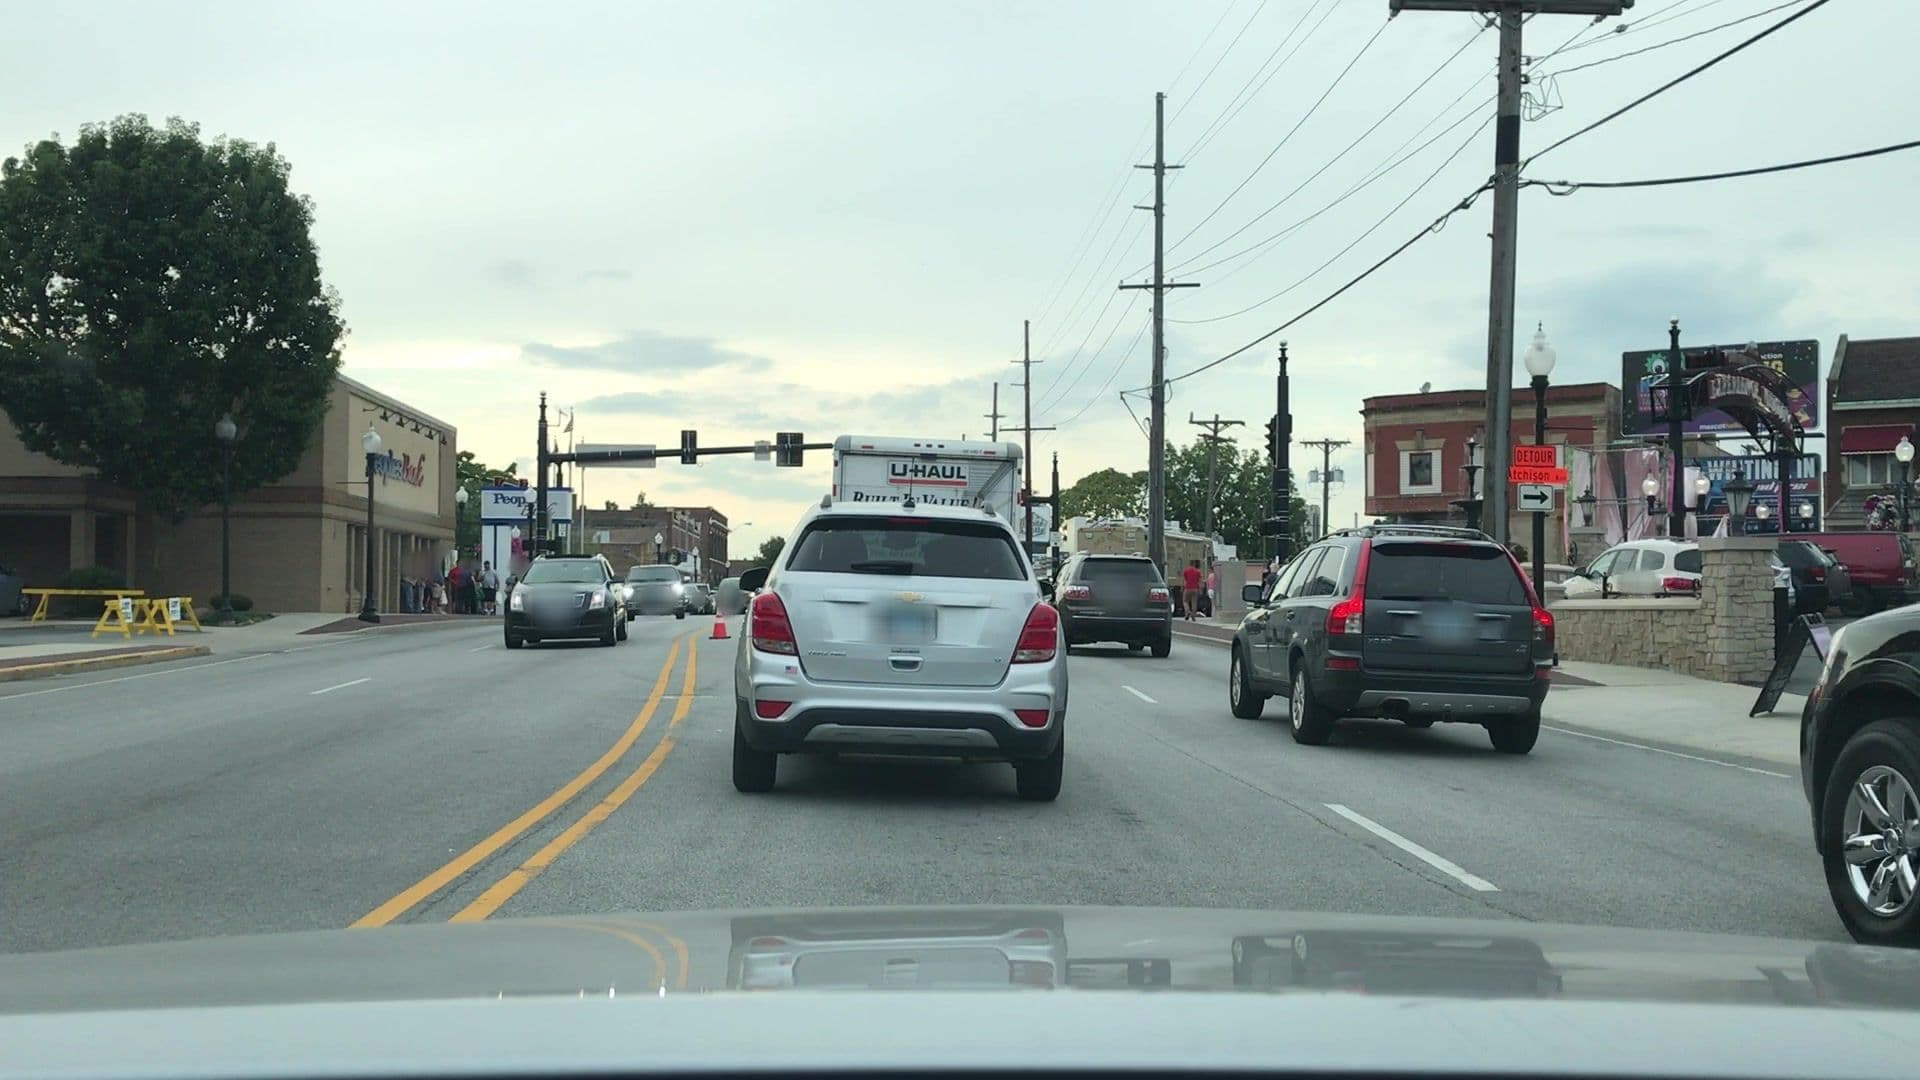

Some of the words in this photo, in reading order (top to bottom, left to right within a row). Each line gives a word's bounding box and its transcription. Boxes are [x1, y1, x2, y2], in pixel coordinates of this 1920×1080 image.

[1516, 450, 1553, 463] DETOUR
[890, 463, 967, 479] U-HAUL
[1796, 457, 1816, 479] IN
[493, 493, 528, 508] Peop
